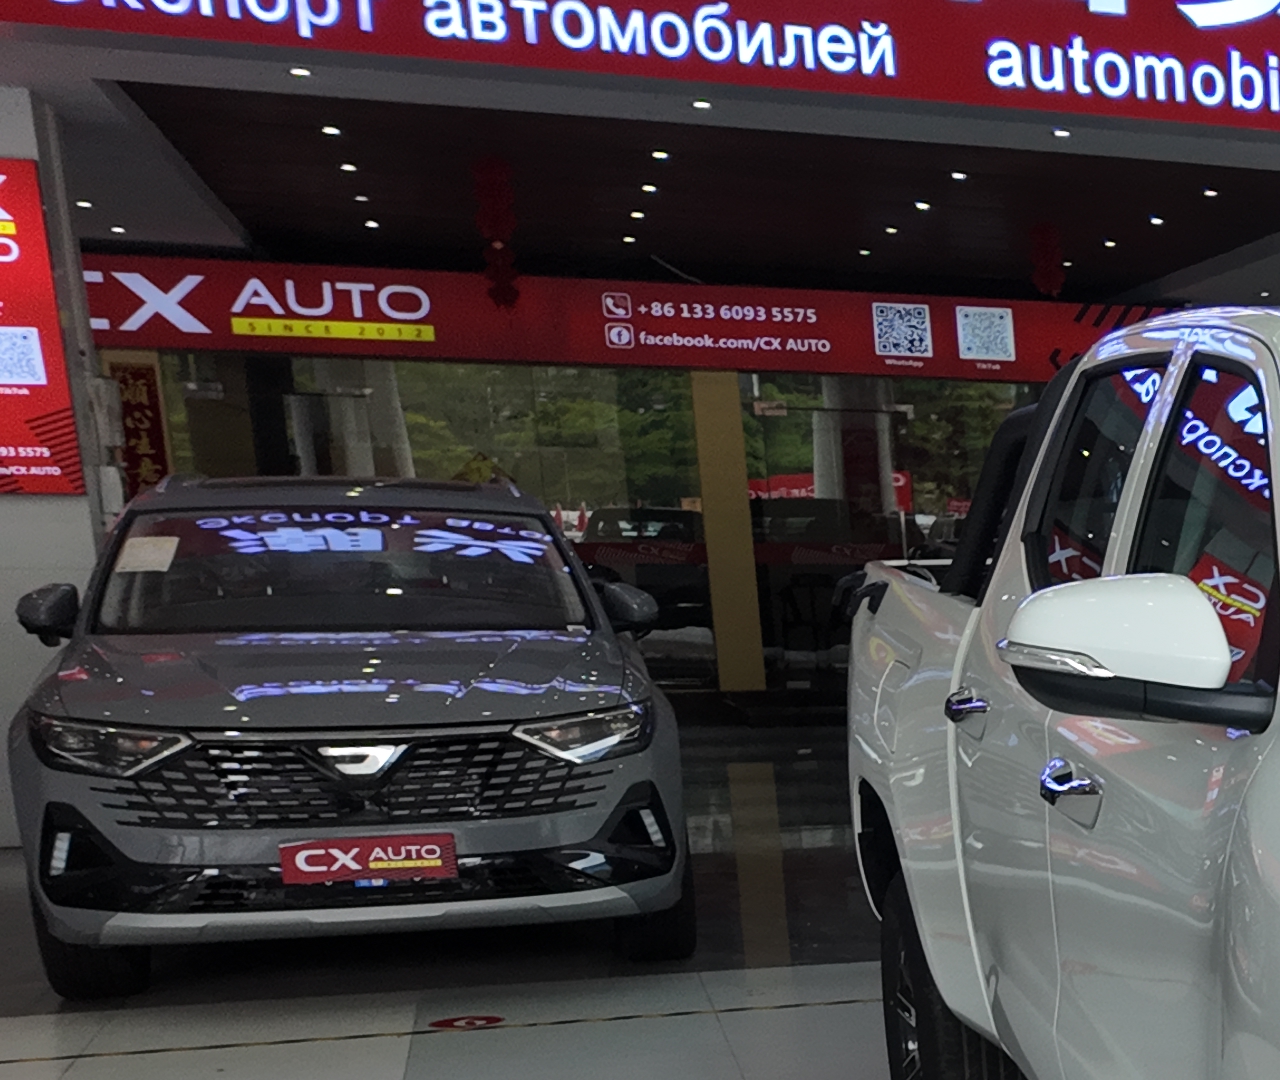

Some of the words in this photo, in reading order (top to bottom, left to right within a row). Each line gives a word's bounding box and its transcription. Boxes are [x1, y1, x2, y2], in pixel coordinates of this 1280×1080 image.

[423, 0, 896, 77] автомобилей
[231, 277, 431, 320] AUTO
[637, 302, 674, 319] +86
[680, 302, 715, 320] 133
[720, 304, 767, 322] 6093
[772, 306, 817, 323] 5575
[639, 330, 782, 353] facebook.com/CX
[786, 336, 831, 353] AUTO
[295, 848, 362, 872] CX
[369, 844, 441, 861] AUTO
